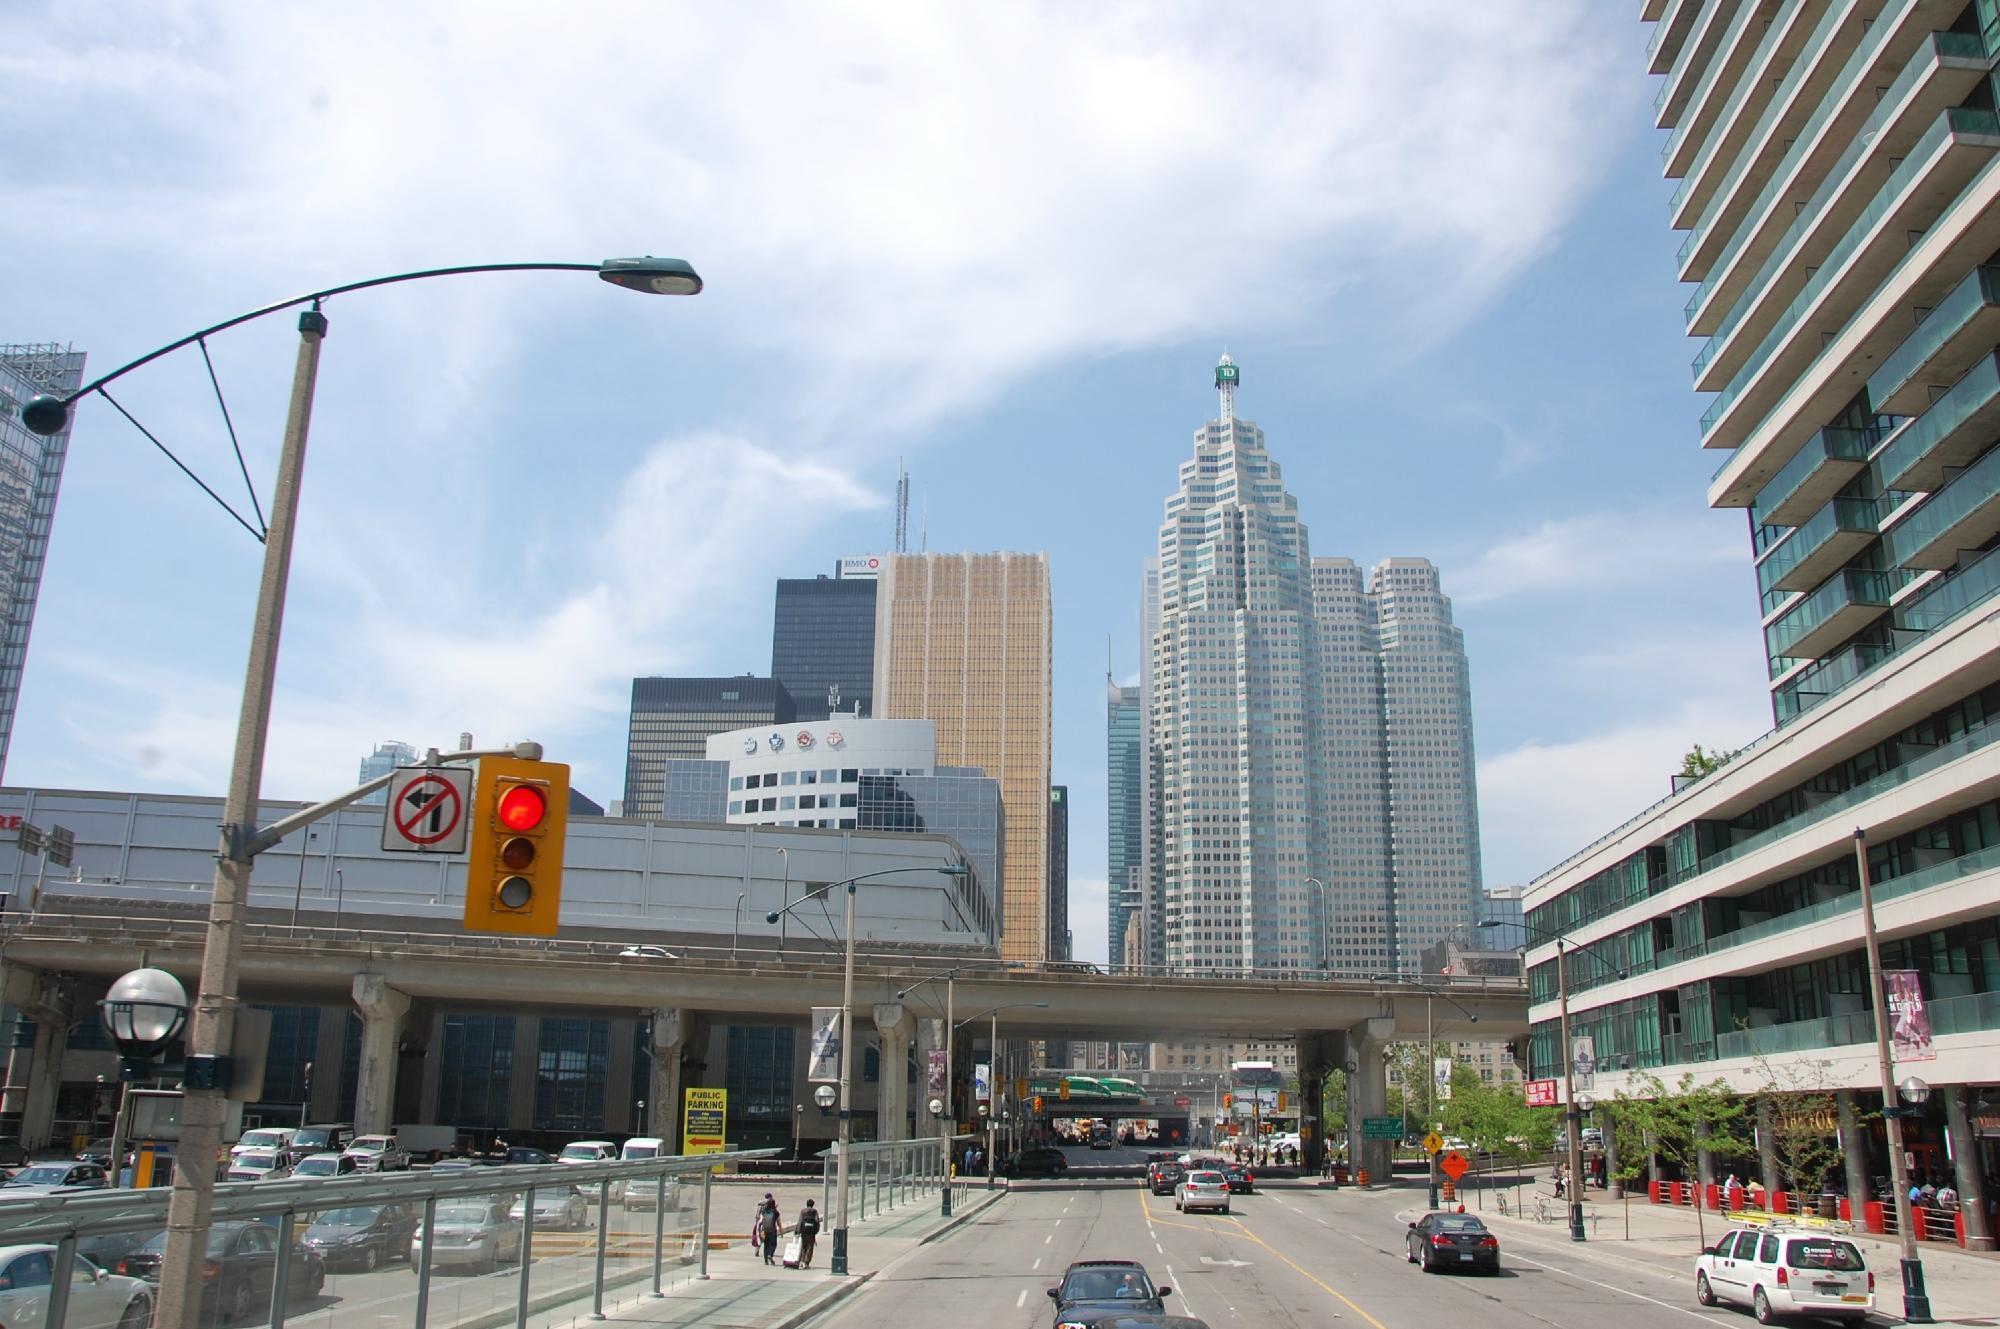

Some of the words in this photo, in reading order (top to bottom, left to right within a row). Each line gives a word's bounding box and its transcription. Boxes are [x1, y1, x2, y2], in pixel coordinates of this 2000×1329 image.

[844, 560, 867, 568] BMO
[691, 1091, 720, 1099] PUBLIC
[688, 1100, 724, 1109] PARKING
